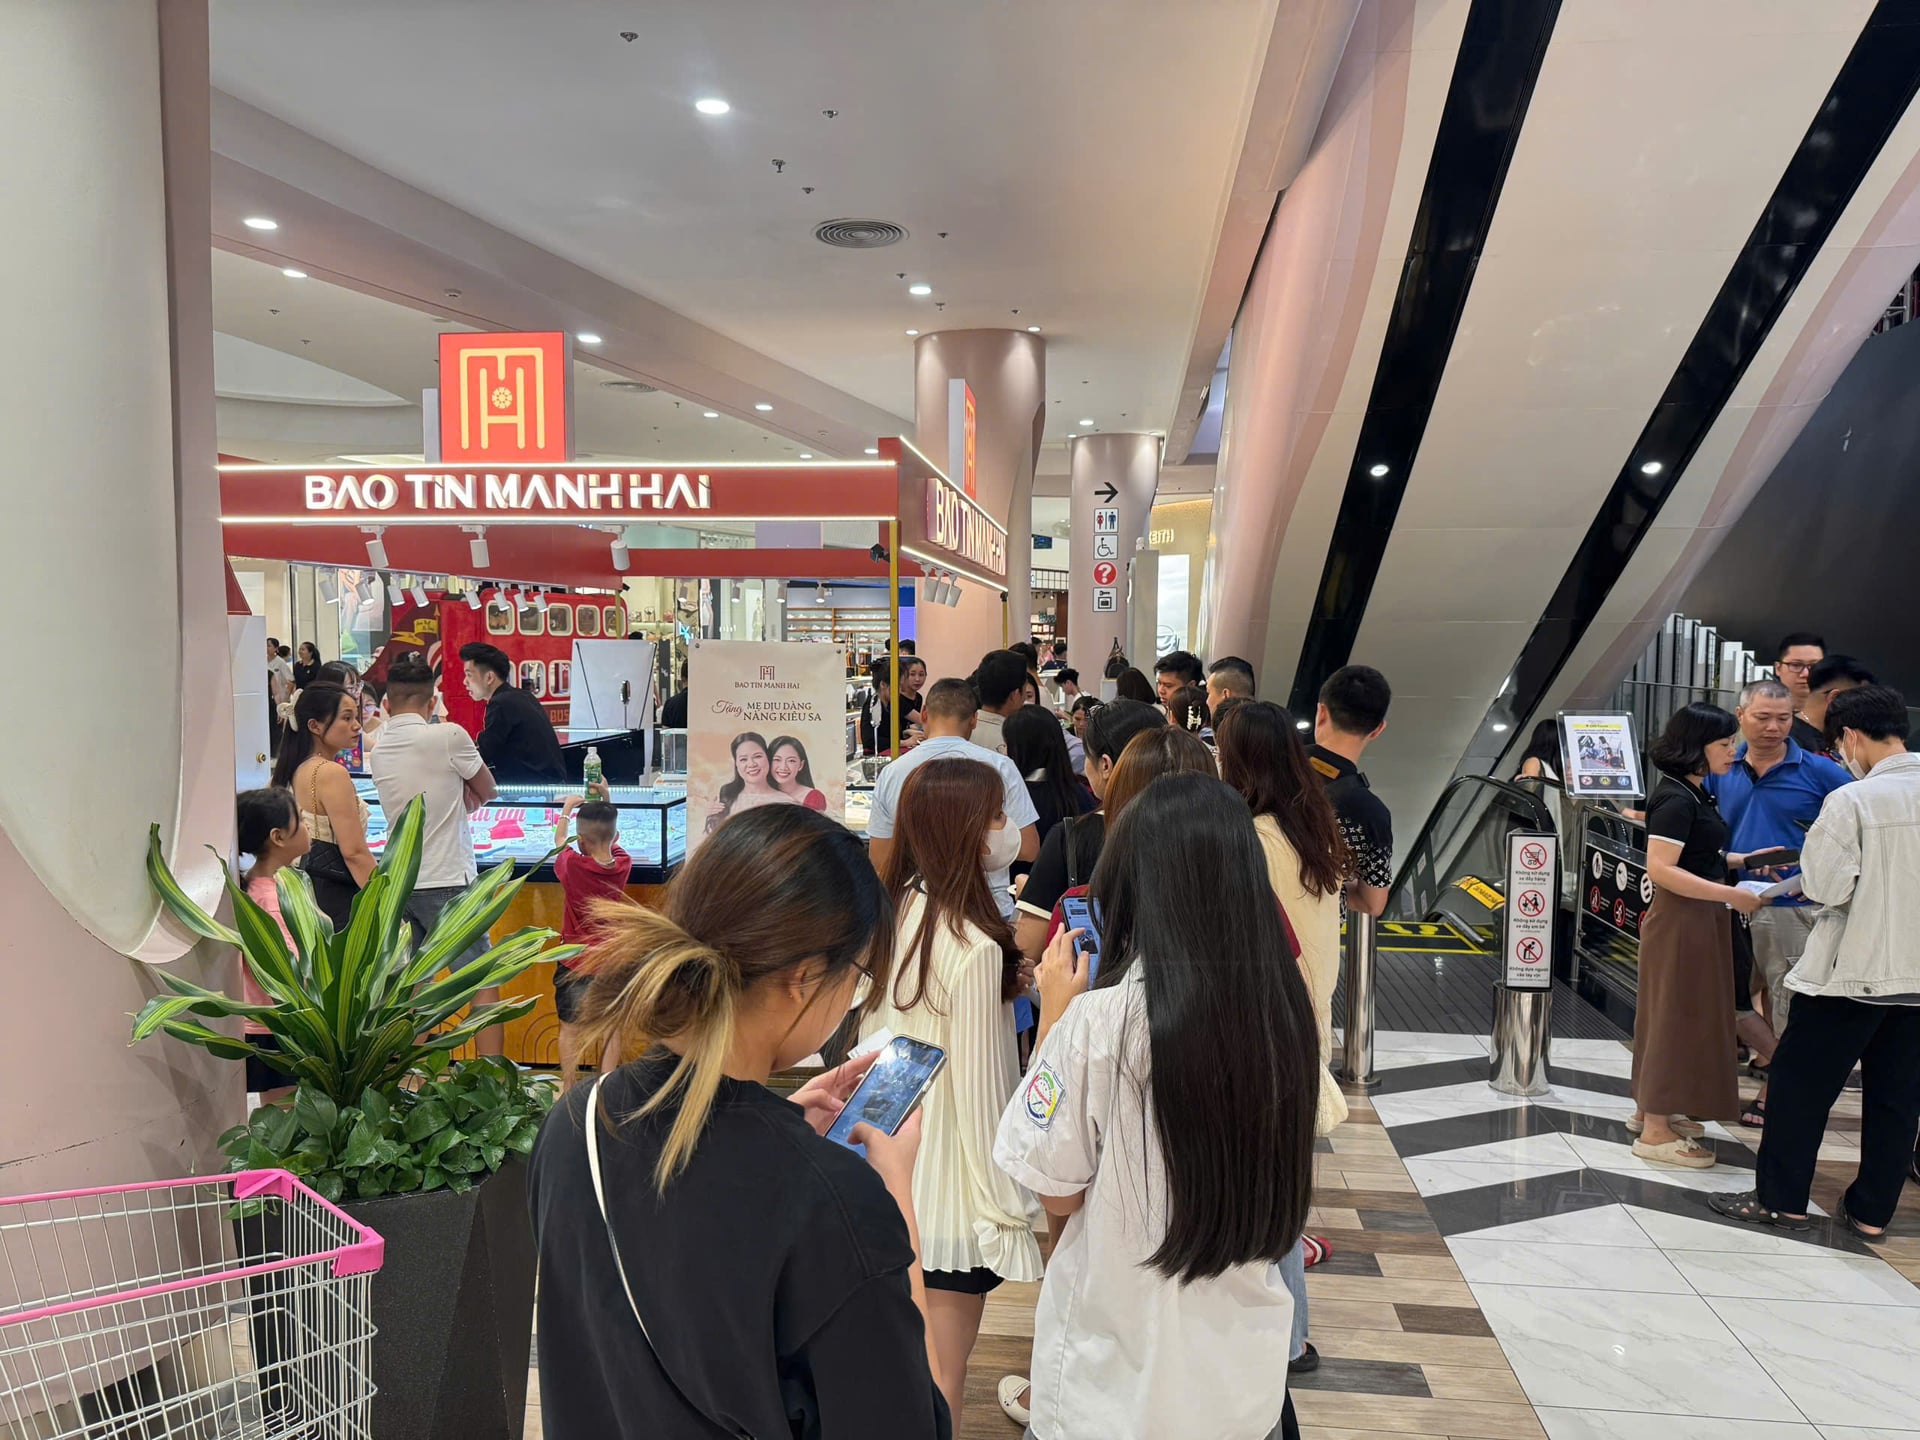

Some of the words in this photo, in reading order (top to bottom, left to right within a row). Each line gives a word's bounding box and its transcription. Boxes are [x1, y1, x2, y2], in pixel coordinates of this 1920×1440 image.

[305, 474, 399, 510] BAO
[404, 474, 478, 509] TIN
[485, 473, 624, 509] MANH
[629, 473, 711, 509] HAI
[734, 681, 750, 689] BAO
[751, 681, 763, 689] TIN
[763, 681, 786, 689] MANH
[747, 701, 761, 712] MẸ
[783, 700, 812, 710] DÀNG
[743, 710, 777, 721] NÀNG
[808, 712, 822, 721] SA
